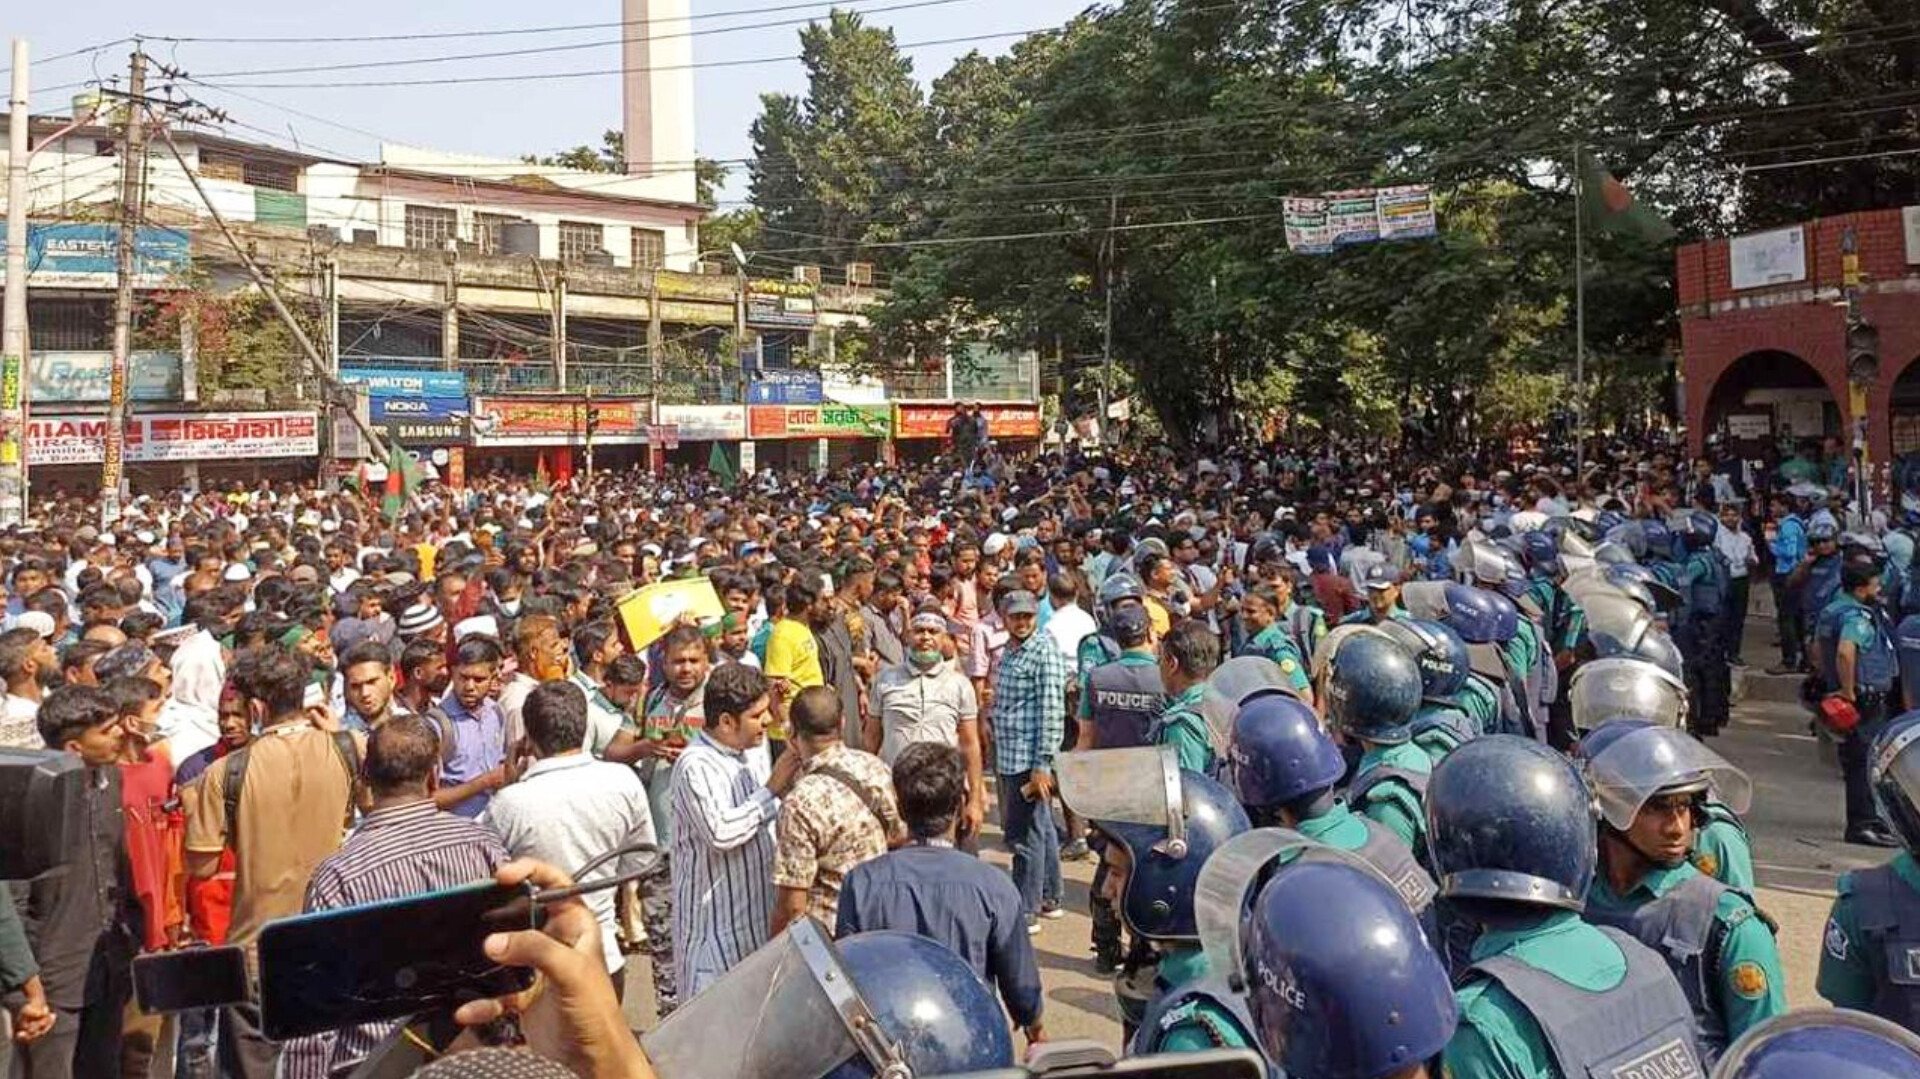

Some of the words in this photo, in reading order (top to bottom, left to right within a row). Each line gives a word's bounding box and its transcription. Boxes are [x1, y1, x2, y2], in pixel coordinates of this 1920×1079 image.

[368, 376, 423, 388] WALTON
[384, 401, 430, 412] NOKIA
[28, 421, 107, 438] MIAM
[398, 425, 461, 437] SAMSUNG
[1422, 658, 1454, 674] POLICE
[1097, 690, 1153, 709] POLICE
[1257, 960, 1307, 1010] POLICE
